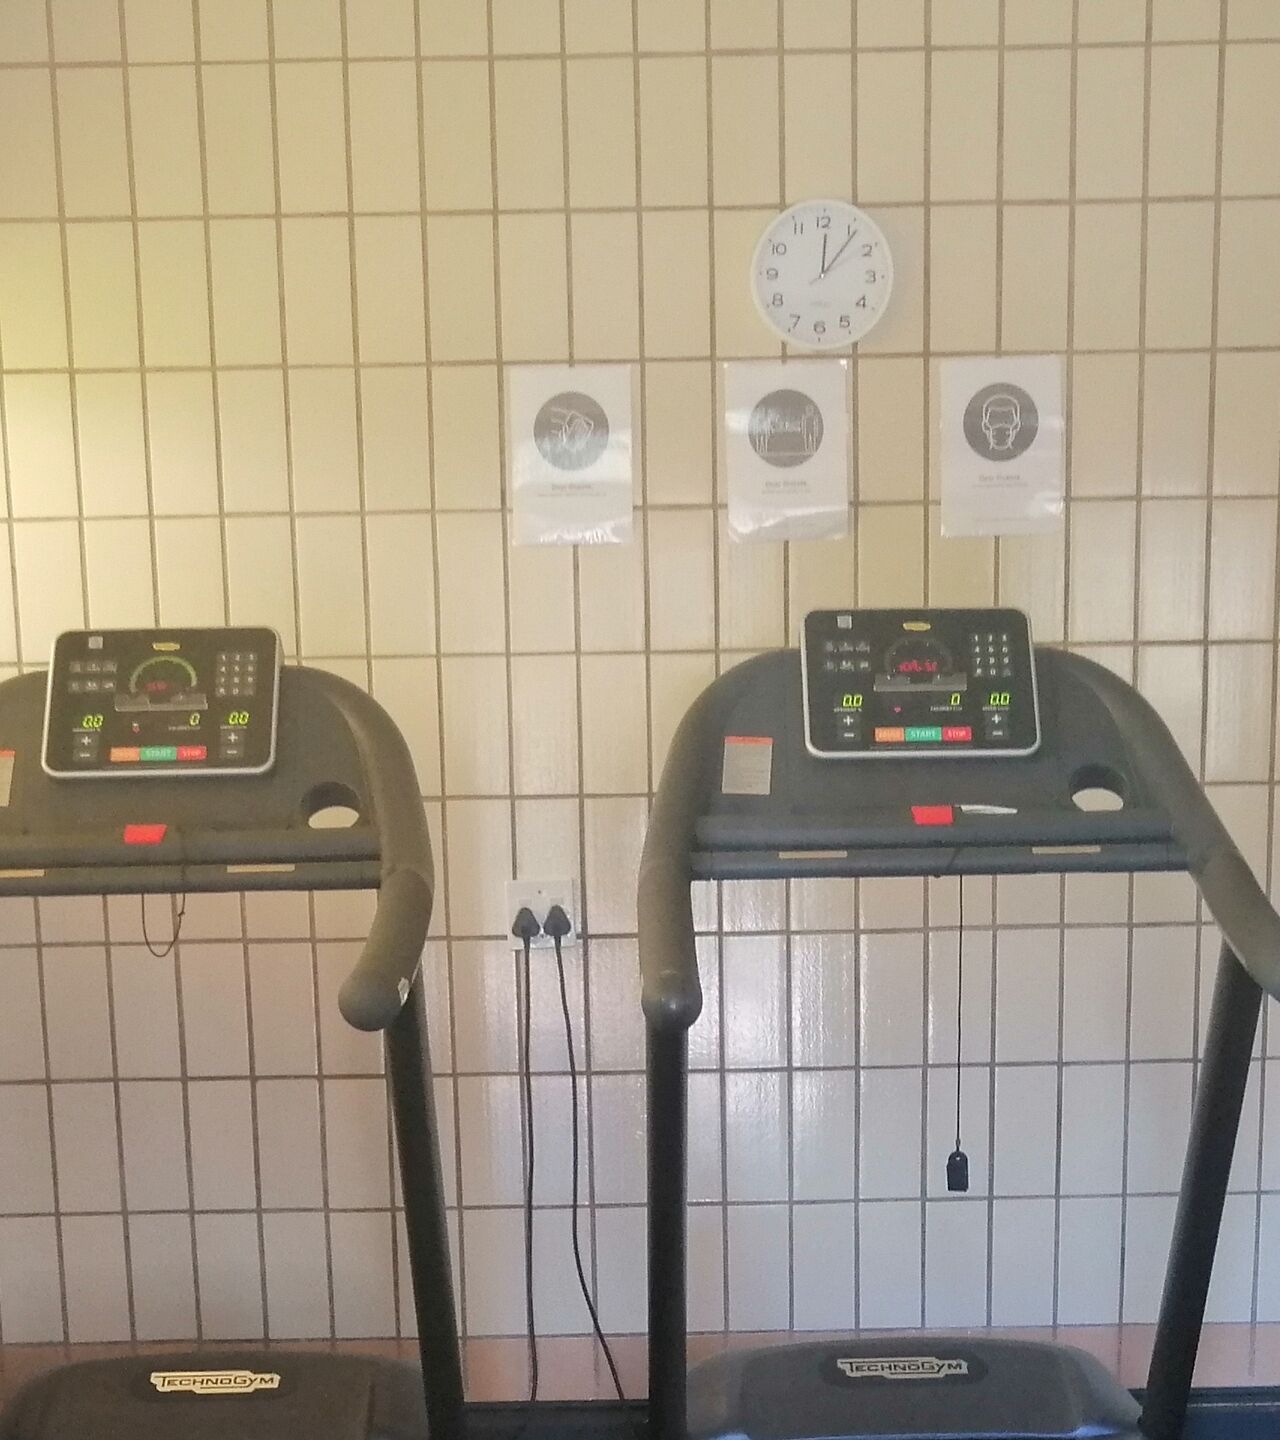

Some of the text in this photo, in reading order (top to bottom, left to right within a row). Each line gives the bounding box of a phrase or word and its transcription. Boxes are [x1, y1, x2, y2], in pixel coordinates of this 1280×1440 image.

[793, 221, 804, 235] 11
[816, 216, 831, 229] 12
[772, 243, 787, 256] 10
[862, 244, 873, 257] 2
[766, 268, 779, 281] 9
[865, 270, 876, 284] 3
[772, 293, 784, 307] 8
[856, 295, 867, 309] 4
[789, 314, 801, 329] 7
[813, 321, 826, 334] 6
[839, 315, 851, 328] 5
[951, 693, 960, 705] 0
[190, 712, 200, 726] 0
[910, 730, 936, 738] START
[948, 730, 967, 738] STOP
